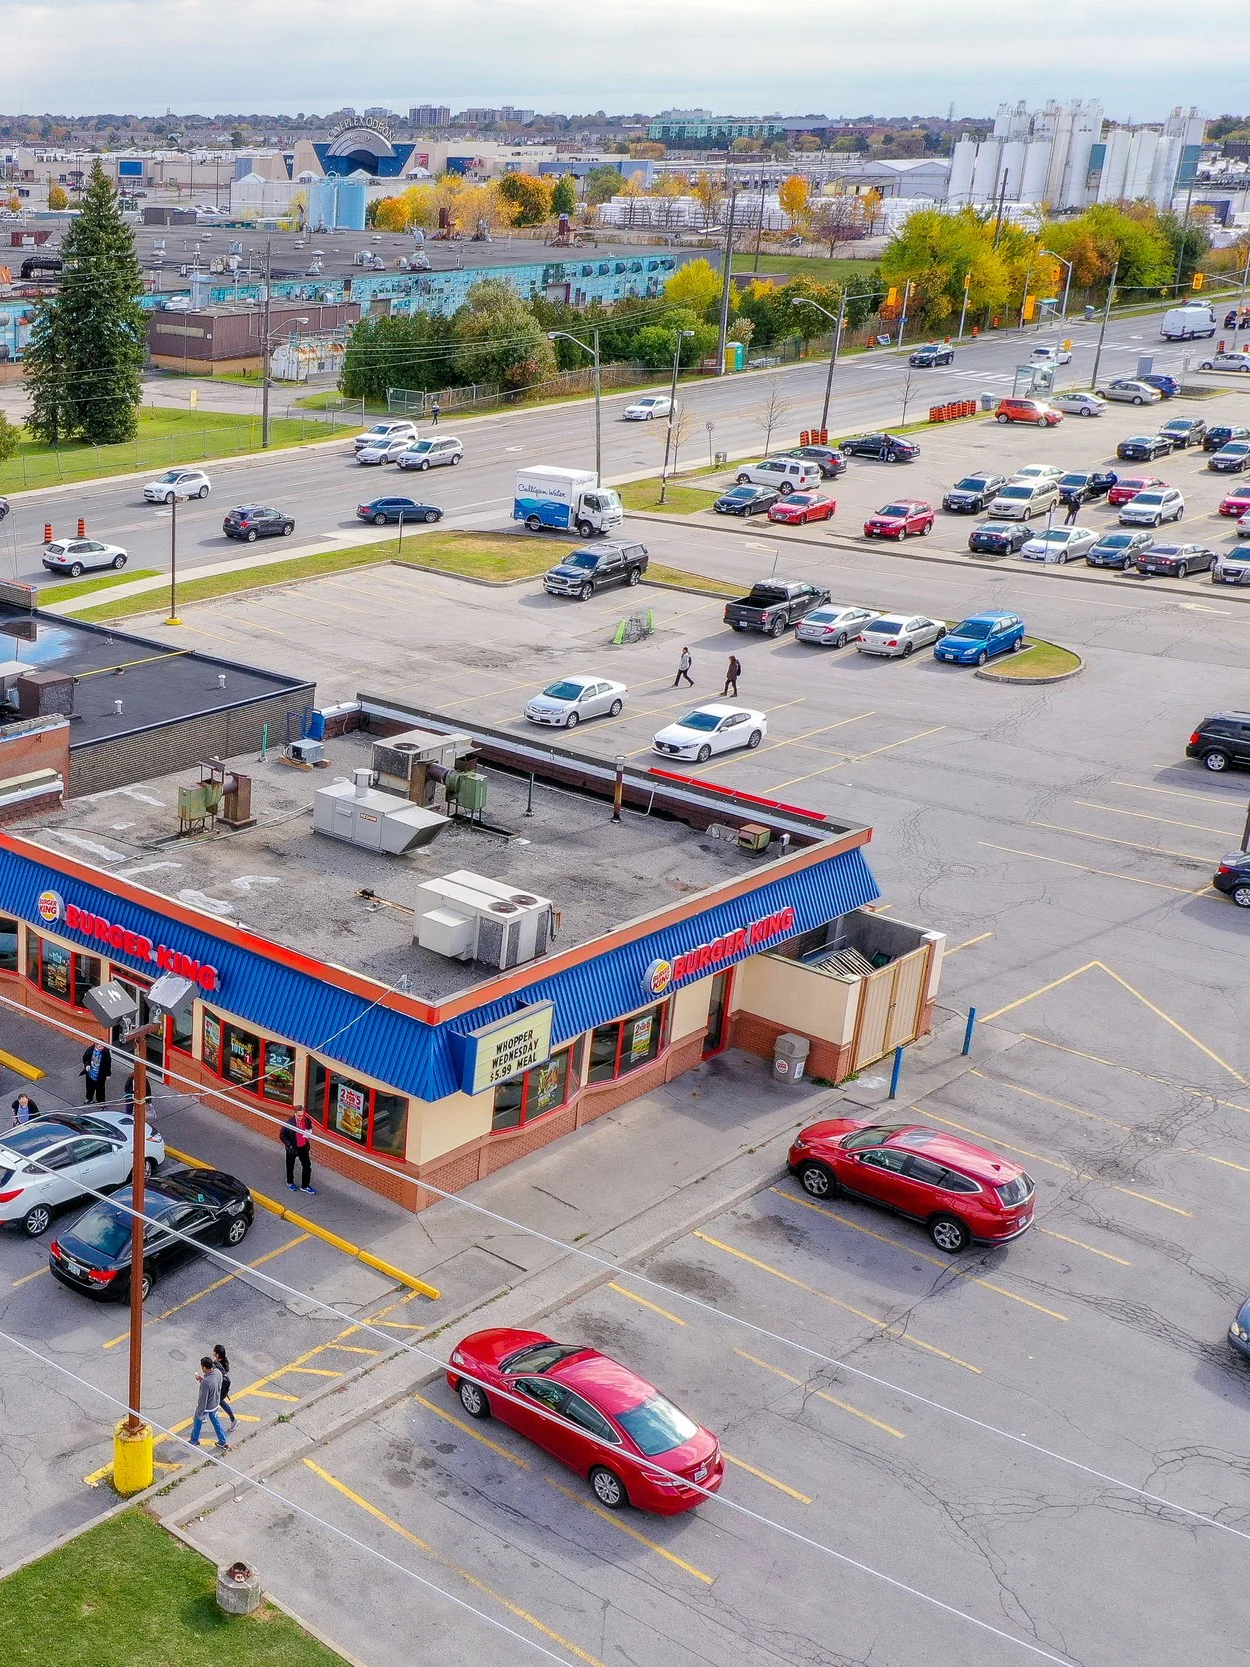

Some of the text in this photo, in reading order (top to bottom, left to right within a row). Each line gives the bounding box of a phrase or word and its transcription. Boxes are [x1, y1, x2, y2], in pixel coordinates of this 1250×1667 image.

[328, 116, 396, 140] CINEPLEX ODEON
[518, 483, 566, 498] Culligan Water
[39, 898, 57, 907] BURGER
[39, 904, 57, 914] KING
[65, 903, 218, 991] BURGER KING
[672, 907, 794, 981] BURGER KING
[653, 966, 670, 983] BURGER
[653, 972, 670, 991] KING
[231, 1042, 244, 1056] TOTS
[496, 1029, 533, 1055] WHOPPER
[270, 1053, 277, 1063] 2
[492, 1038, 539, 1069] WEDNESDAY
[490, 1052, 537, 1082] $5.99 MEAL
[340, 1088, 346, 1098] 2
